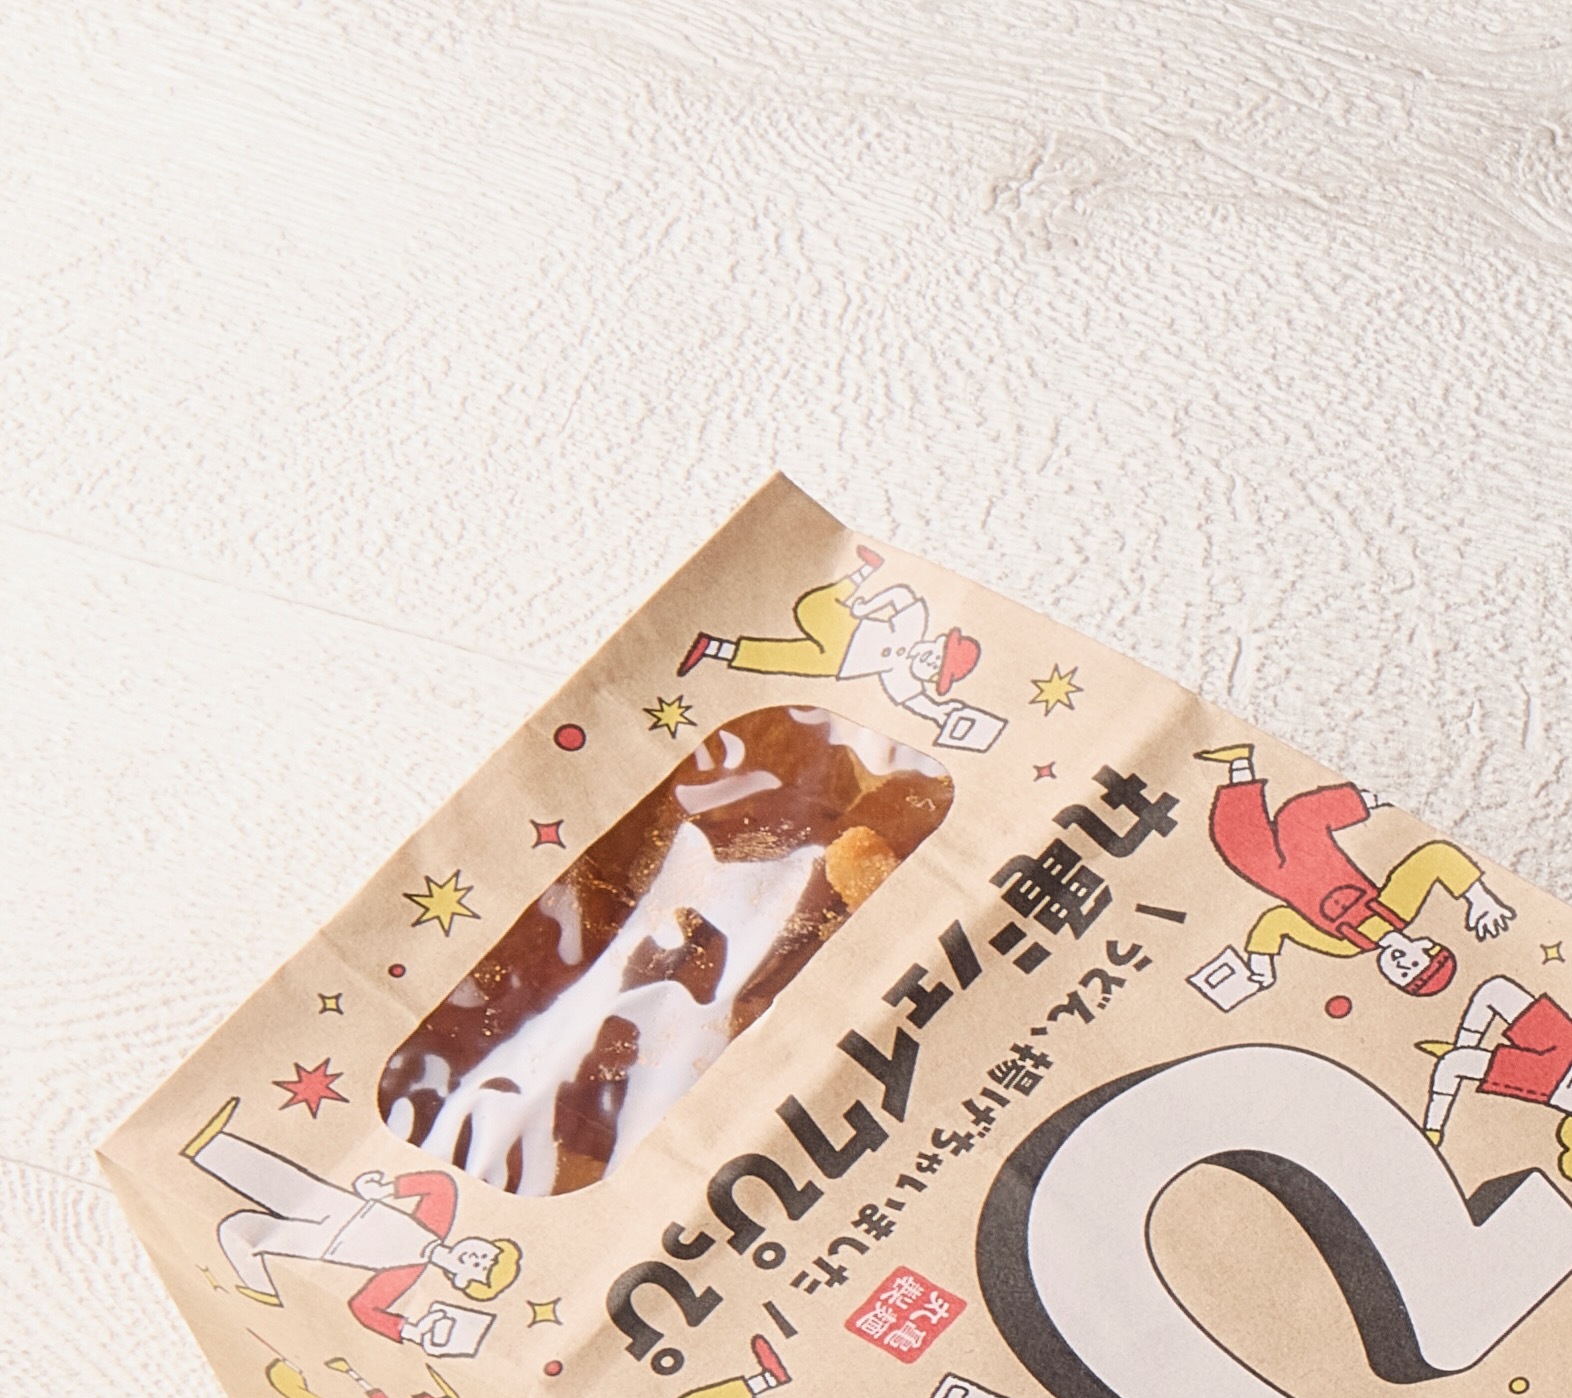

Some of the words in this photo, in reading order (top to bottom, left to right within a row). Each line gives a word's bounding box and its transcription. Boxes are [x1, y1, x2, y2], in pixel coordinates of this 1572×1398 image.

[604, 764, 1180, 1376] 丸亀シェイクぴっぴ
